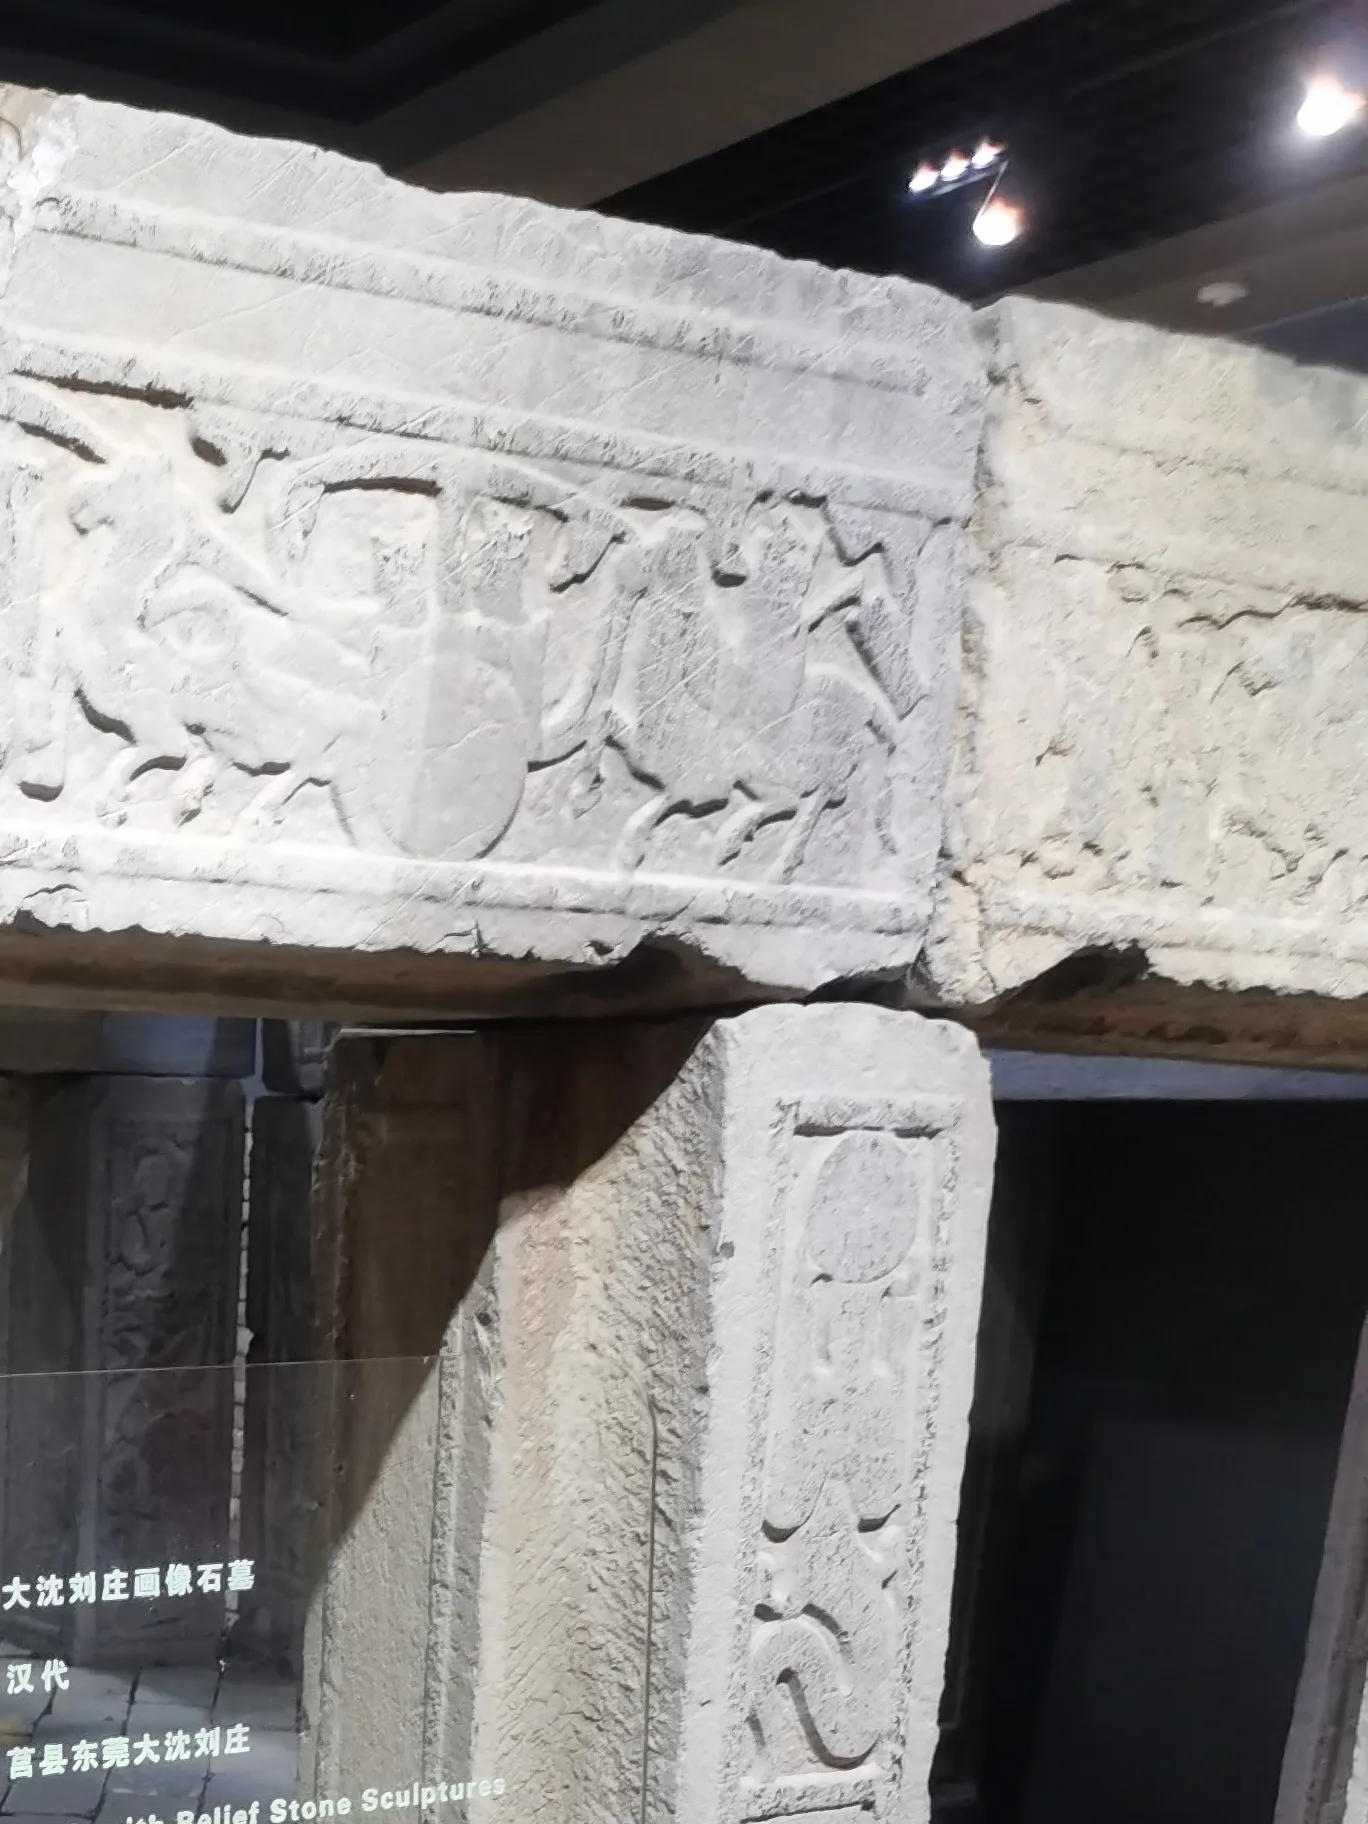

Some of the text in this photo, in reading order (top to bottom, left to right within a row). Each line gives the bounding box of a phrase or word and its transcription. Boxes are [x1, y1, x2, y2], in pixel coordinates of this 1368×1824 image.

[1, 1559, 257, 1611] 大沈刘庄画像石墓
[5, 1658, 71, 1695] 汉代
[5, 1722, 253, 1781] 莒县东莞大沈刘庄
[269, 1797, 353, 1824] Stone
[360, 1776, 507, 1812] Sculptures
